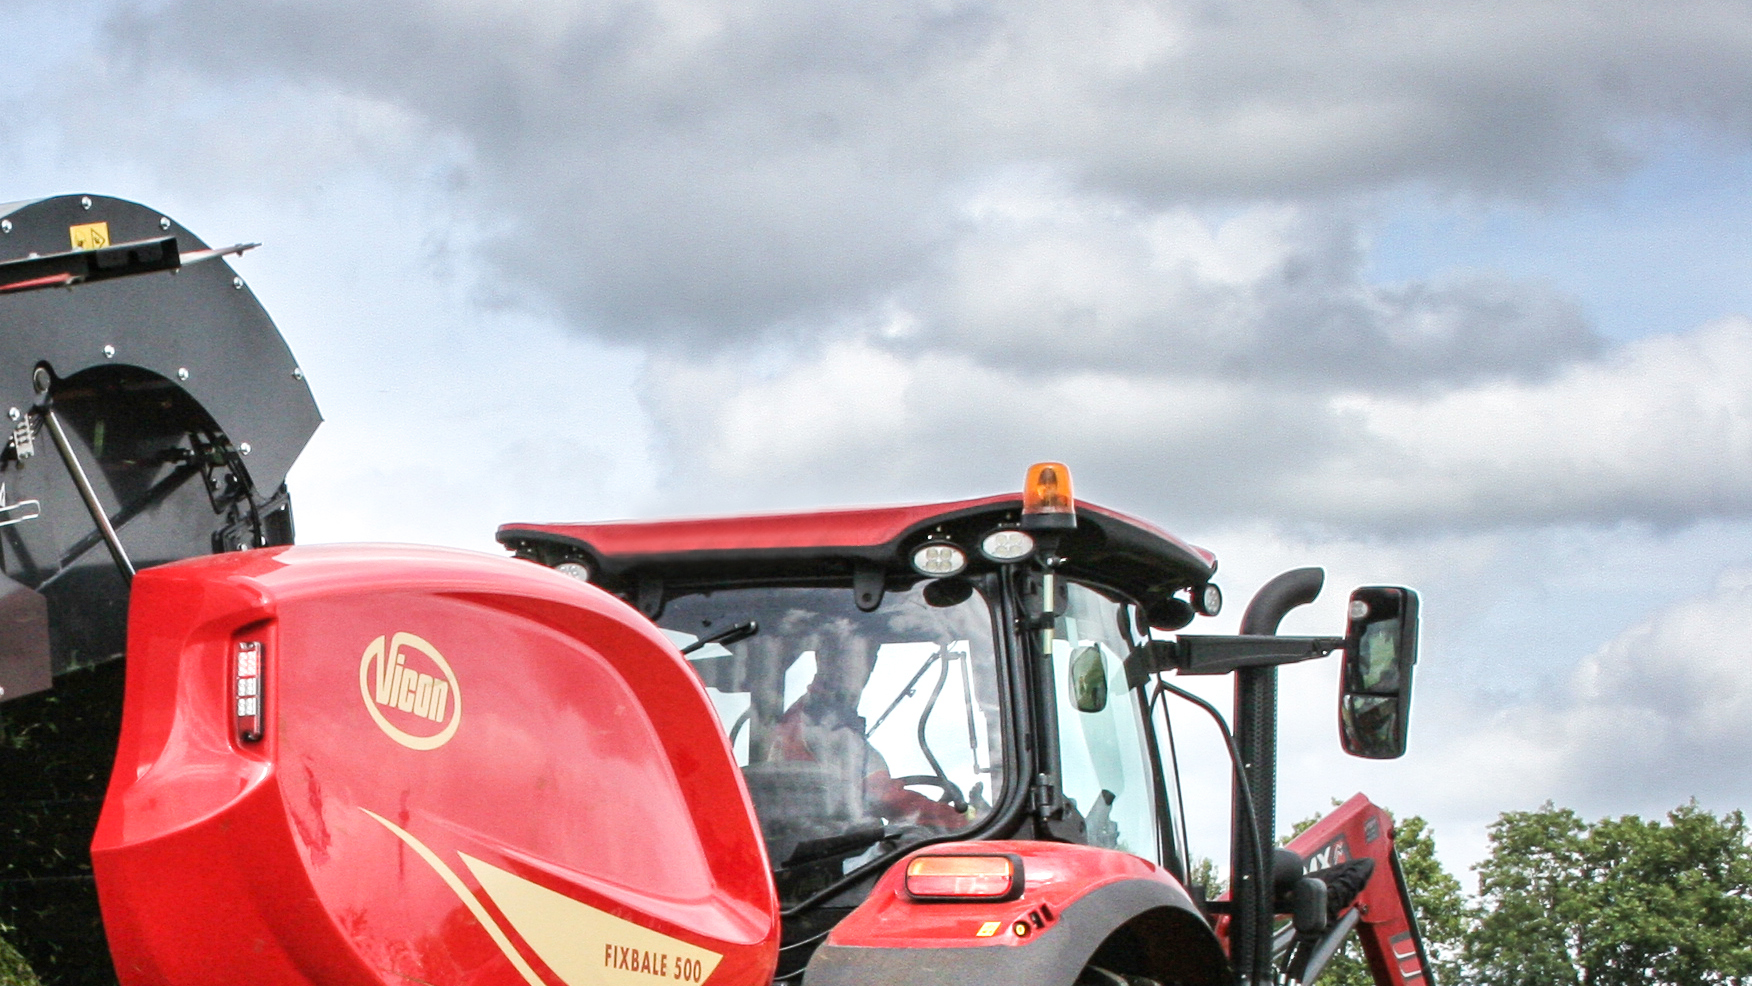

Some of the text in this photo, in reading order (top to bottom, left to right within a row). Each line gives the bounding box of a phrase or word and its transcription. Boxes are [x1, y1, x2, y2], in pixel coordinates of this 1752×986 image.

[374, 633, 448, 723] Vicon
[604, 943, 702, 983] FIXBALE 500
